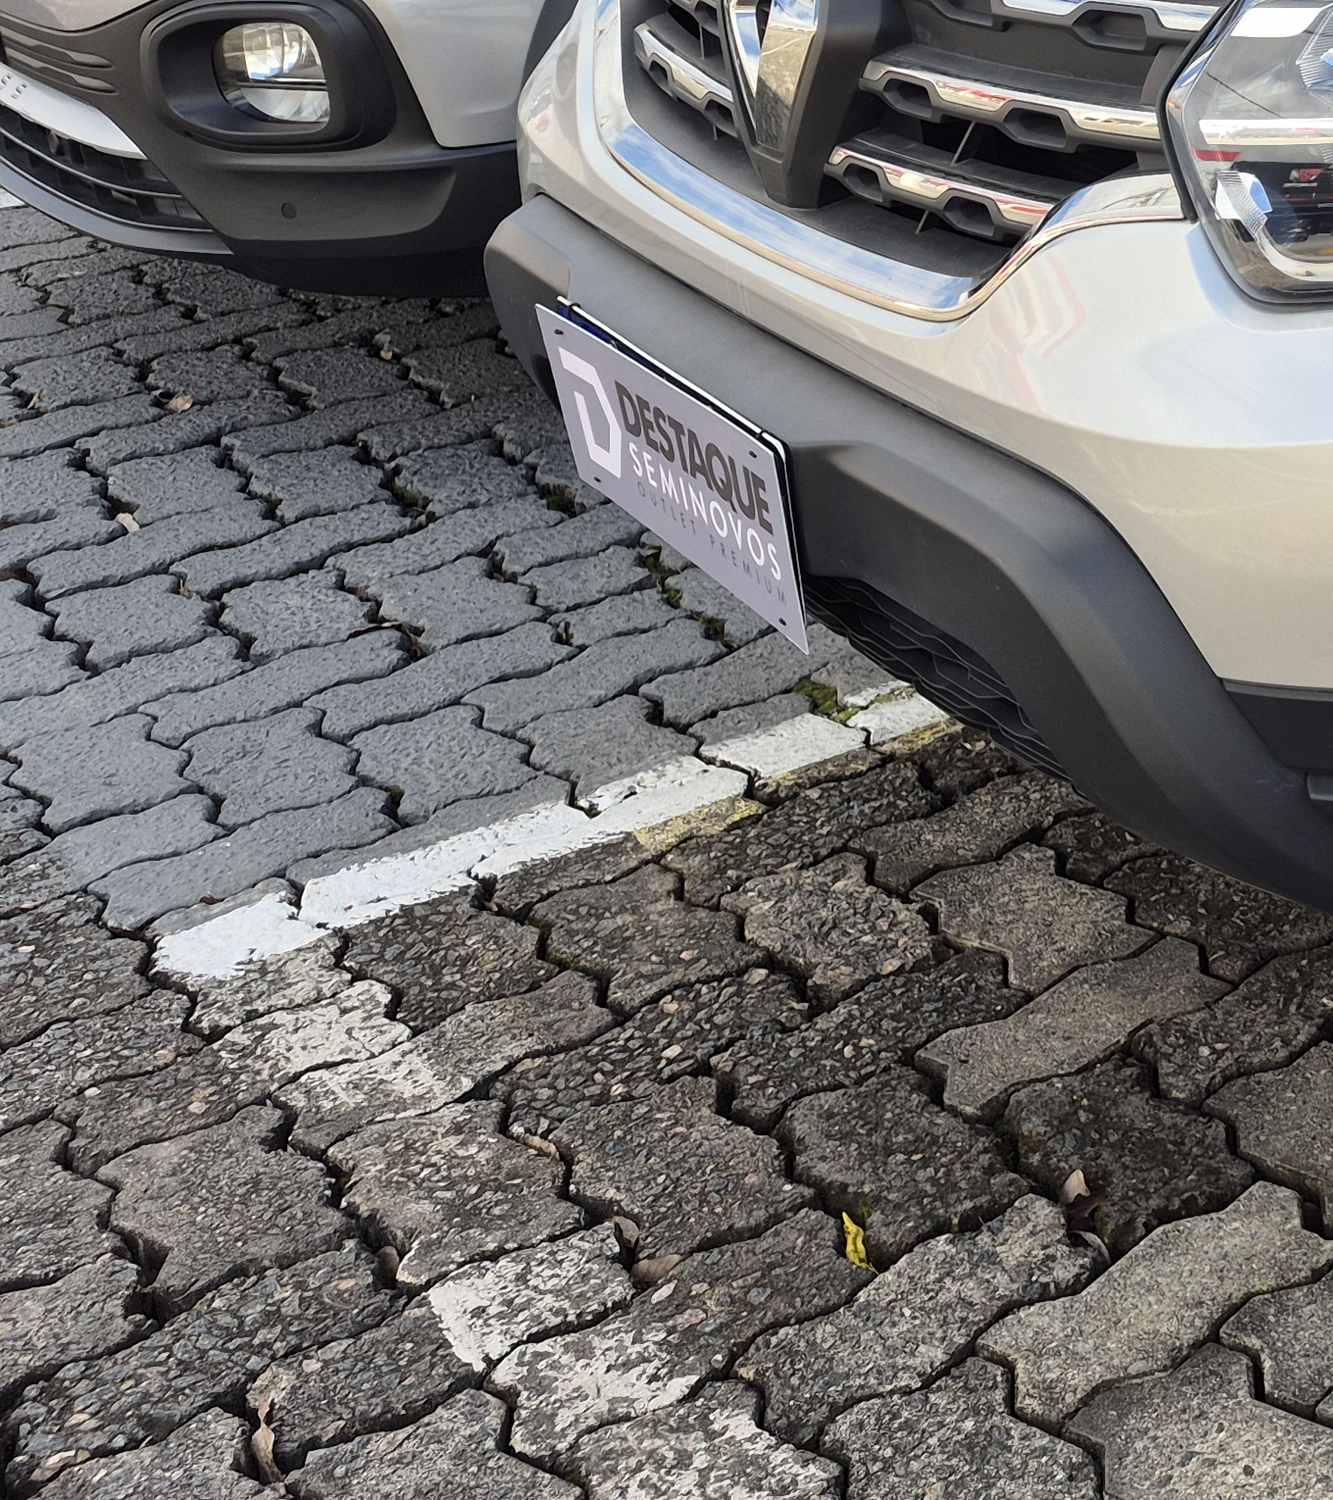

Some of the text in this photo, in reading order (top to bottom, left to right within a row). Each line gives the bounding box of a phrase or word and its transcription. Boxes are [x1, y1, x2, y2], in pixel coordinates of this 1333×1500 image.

[614, 380, 774, 536] DESTAQUE
[628, 442, 782, 582] SEMINOVOS
[637, 481, 788, 607] OUTLET PREMIUM
